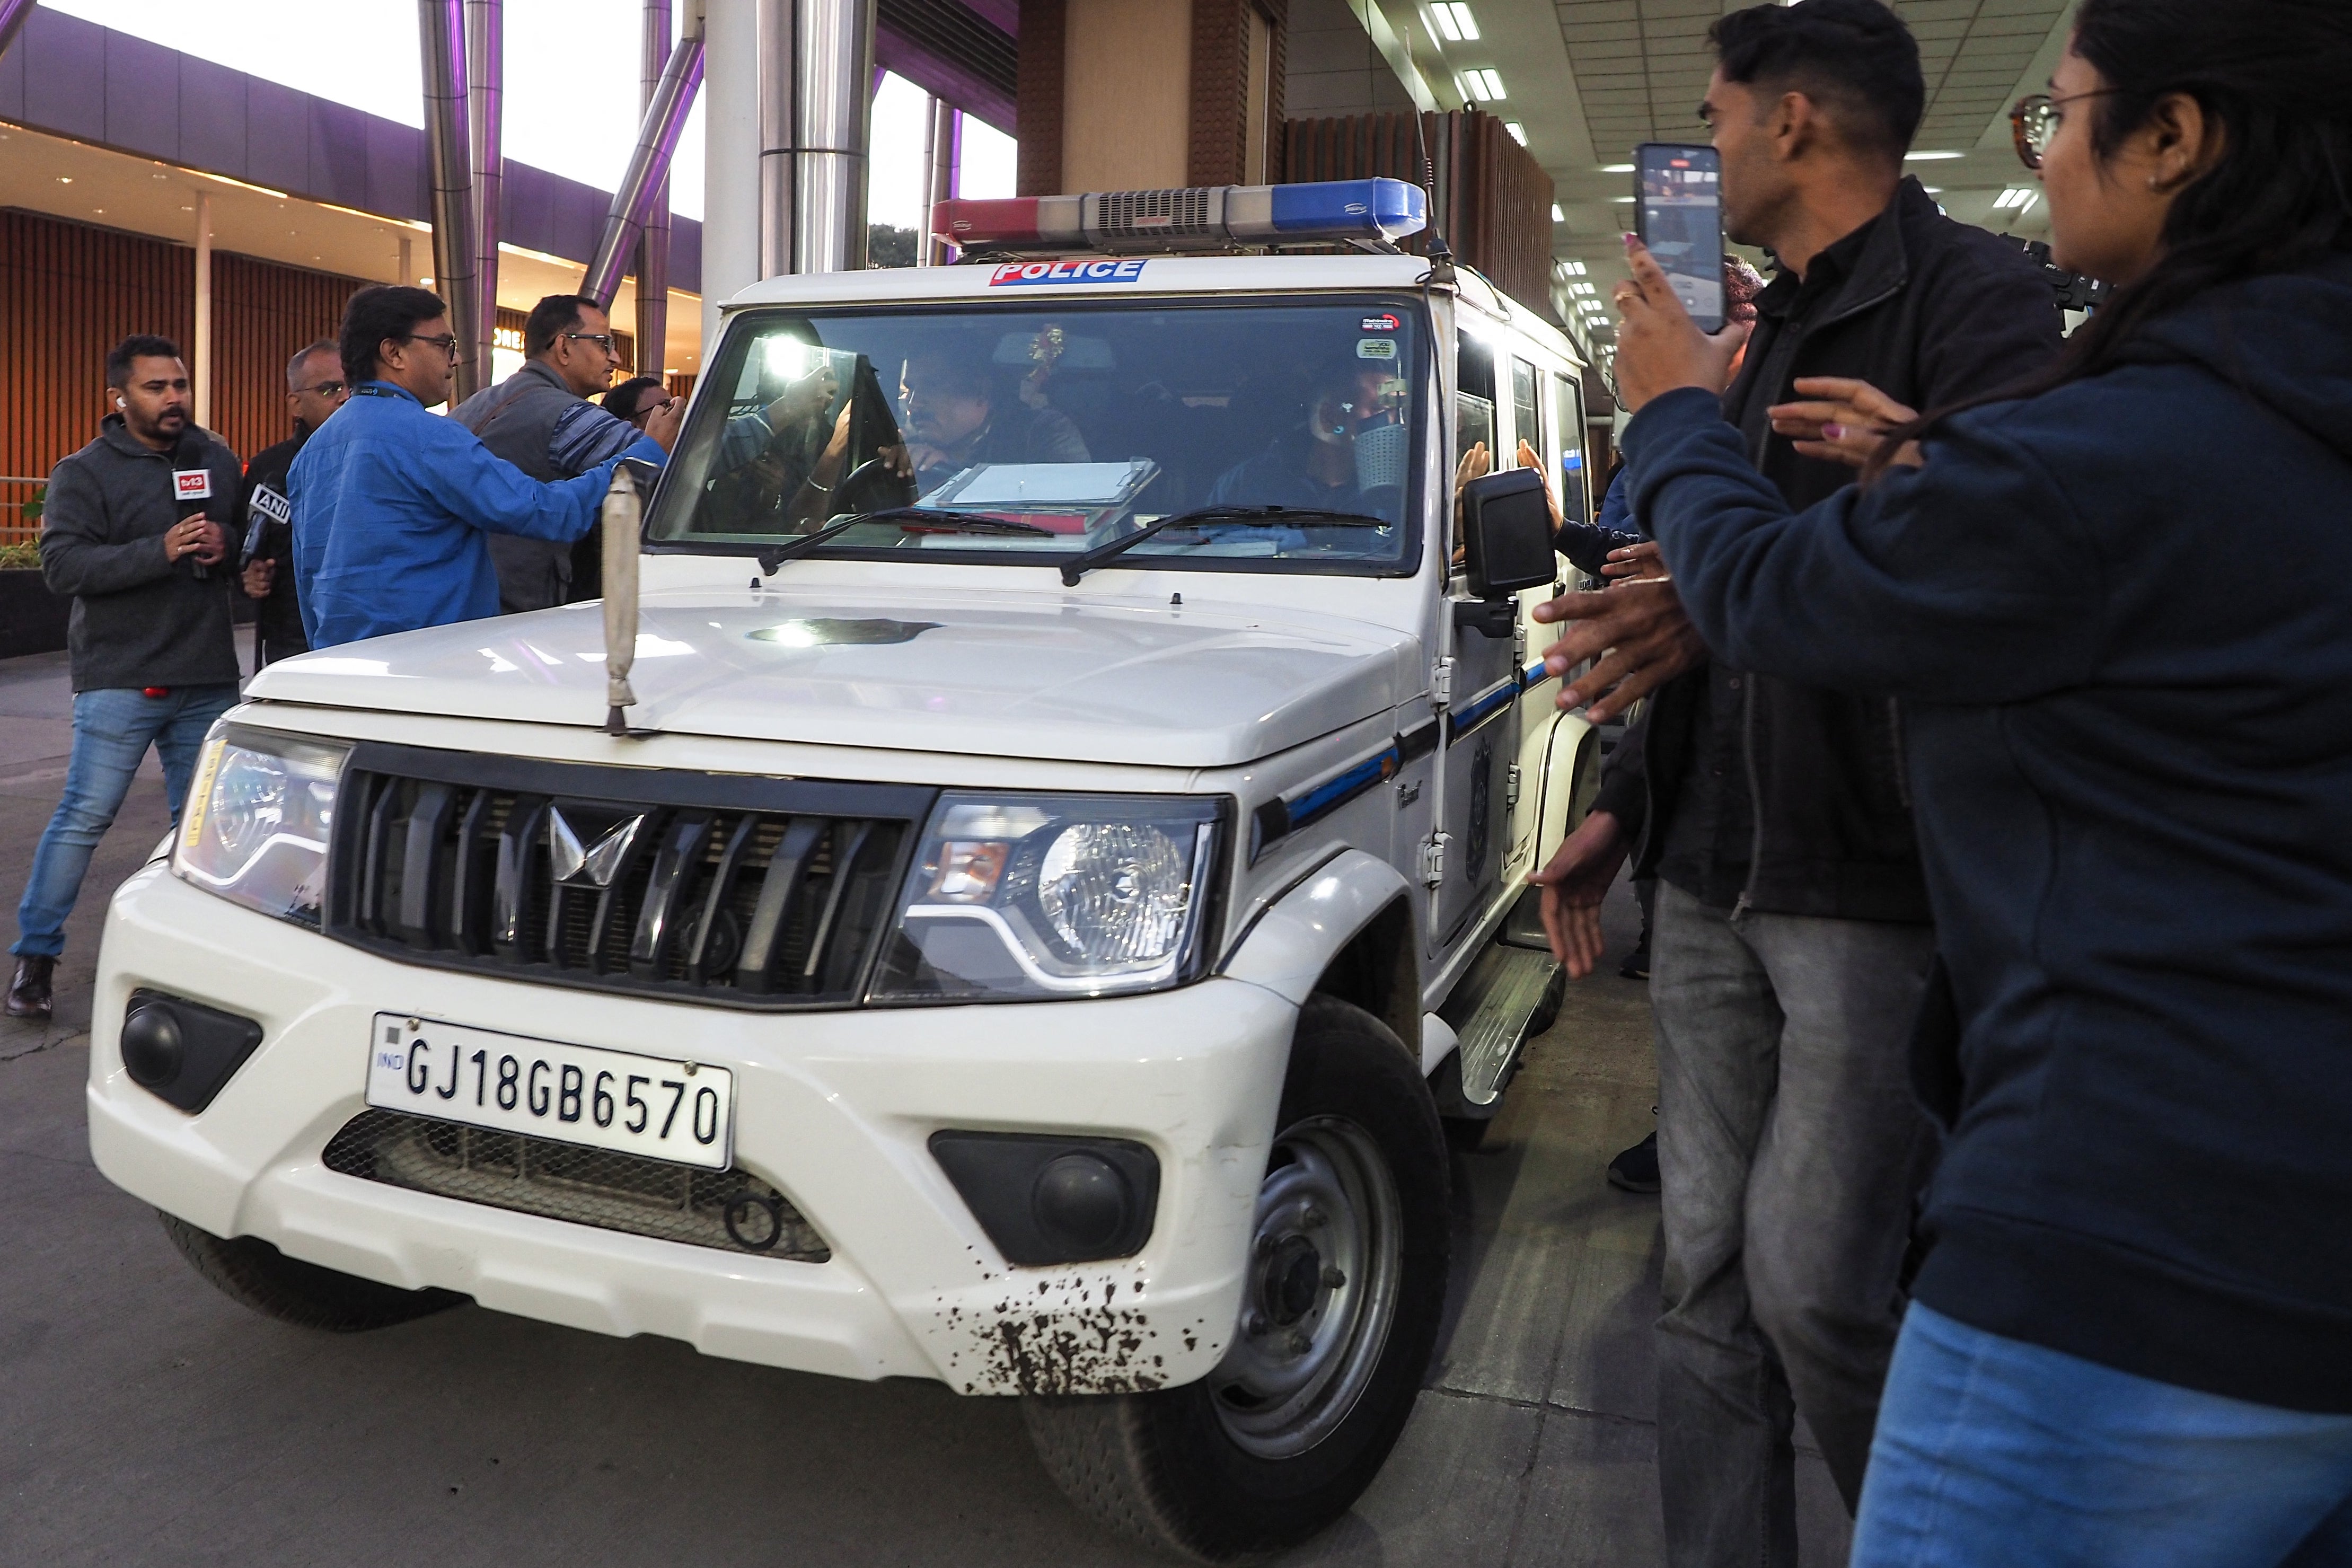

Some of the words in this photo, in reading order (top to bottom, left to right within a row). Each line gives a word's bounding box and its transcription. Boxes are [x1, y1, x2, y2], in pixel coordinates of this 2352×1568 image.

[994, 260, 1146, 280] POLICE
[257, 493, 287, 518] ANI
[377, 1052, 404, 1070] IND
[407, 1039, 718, 1144] GJ18GB6570
